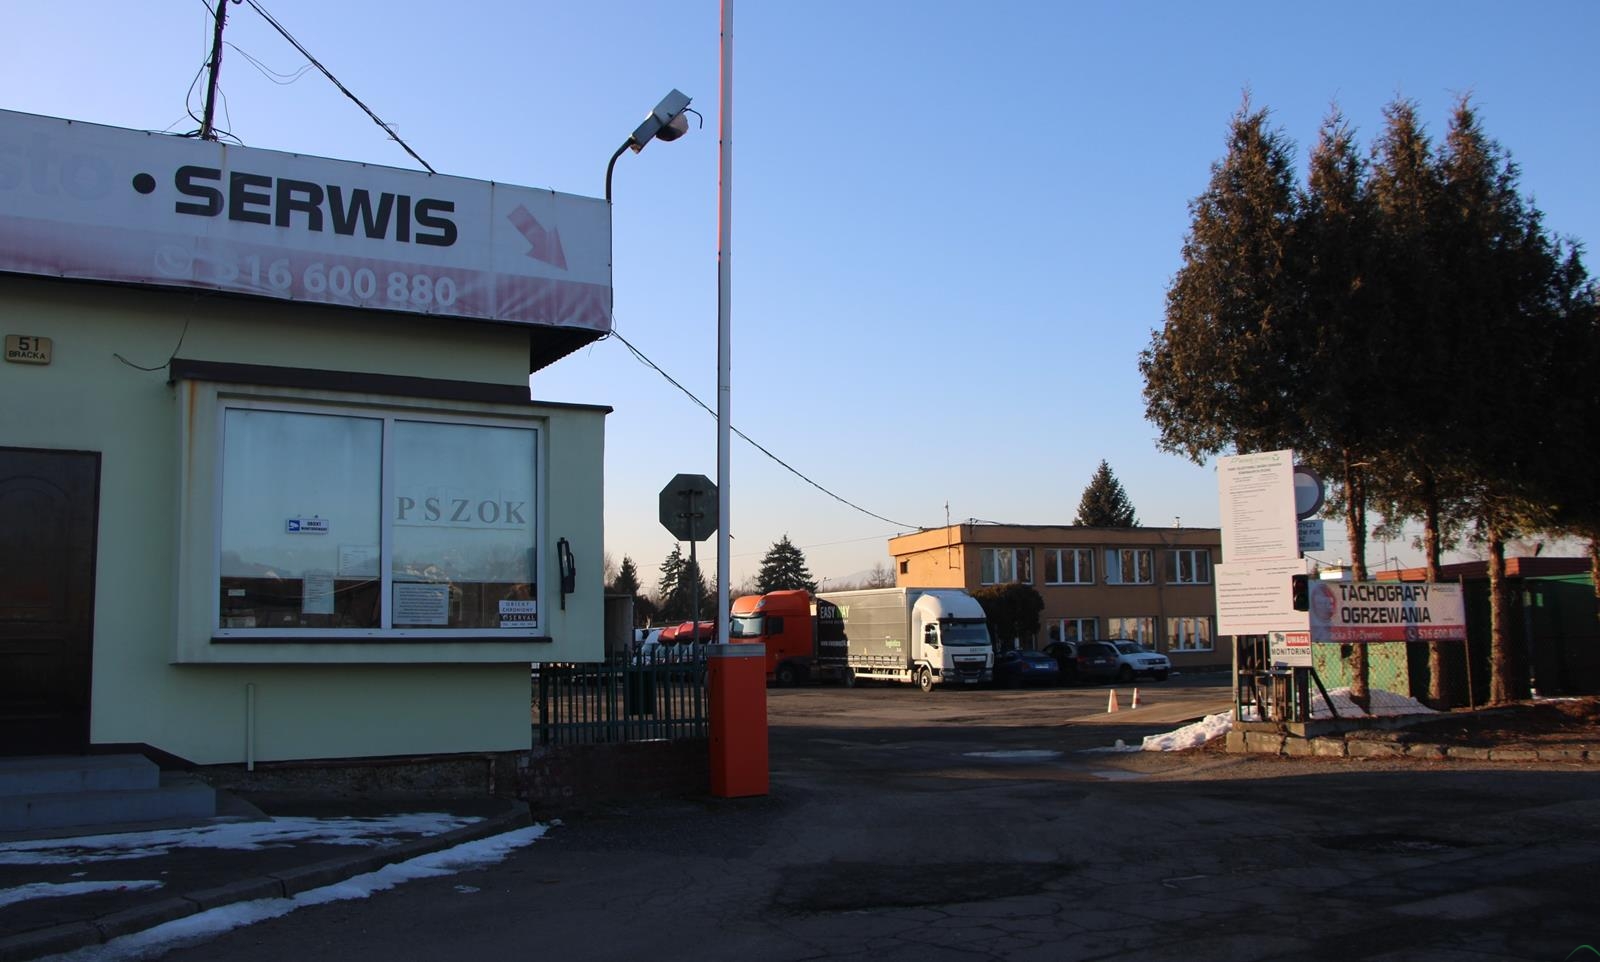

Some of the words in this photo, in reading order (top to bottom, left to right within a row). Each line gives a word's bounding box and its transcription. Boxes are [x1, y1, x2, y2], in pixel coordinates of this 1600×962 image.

[172, 164, 459, 248] SERWIS
[303, 262, 377, 299] 600
[386, 272, 457, 306] 880
[18, 337, 40, 351] 51
[8, 350, 47, 360] BRACKA
[395, 495, 526, 524] PSZOK
[1339, 583, 1429, 602] TACHOGRAFY
[1340, 606, 1431, 624] OGRZEWANIA
[1271, 647, 1311, 655] MONITORING
